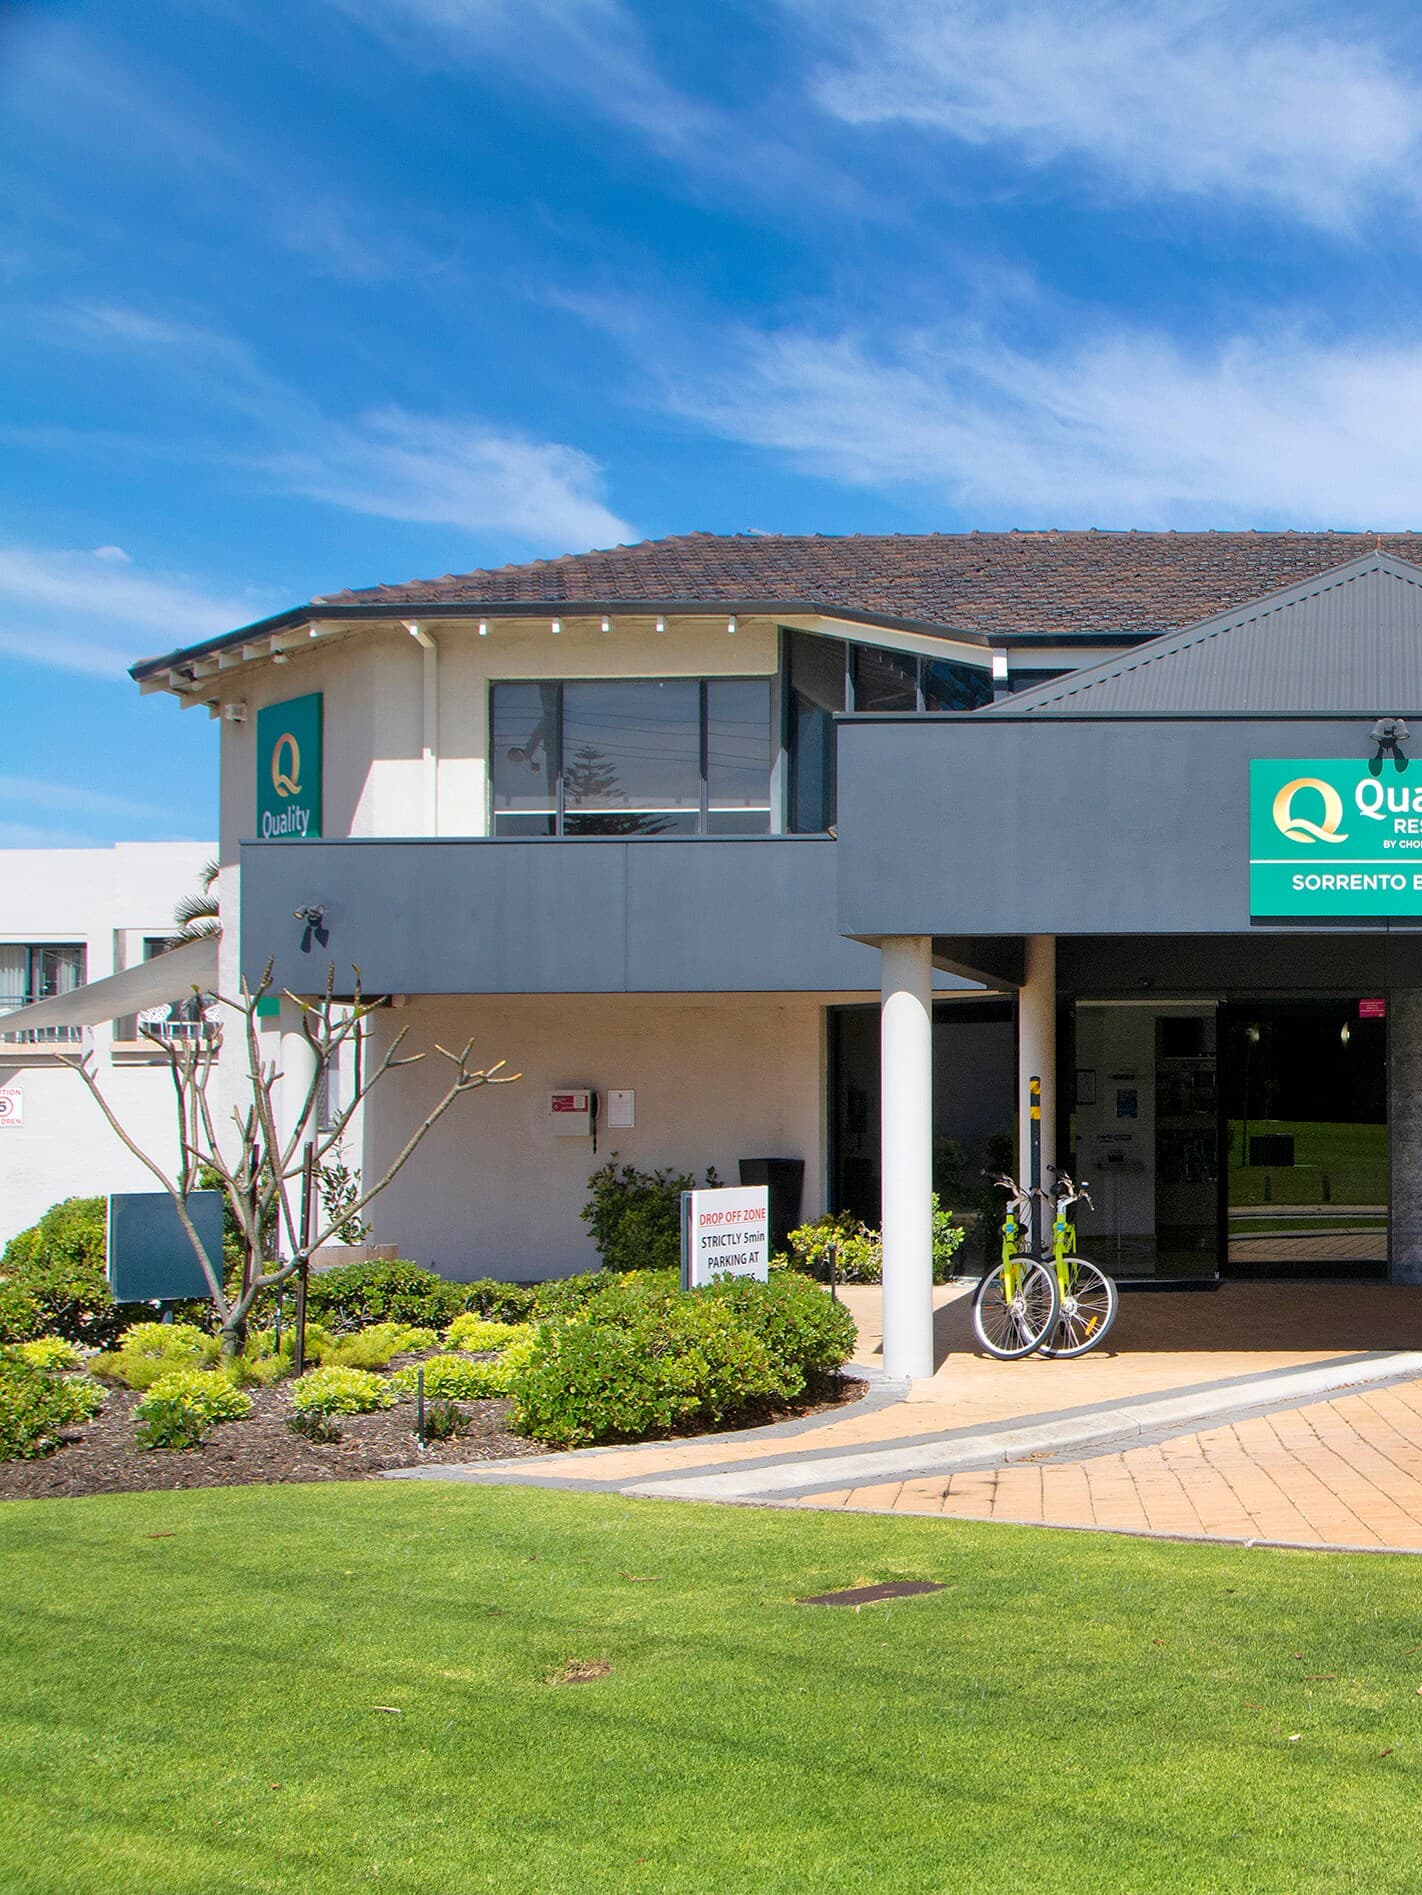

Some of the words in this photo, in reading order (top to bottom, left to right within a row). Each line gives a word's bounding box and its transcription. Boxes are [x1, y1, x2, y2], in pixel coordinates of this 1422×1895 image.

[272, 733, 302, 797] Q
[1272, 777, 1349, 844] Q
[262, 804, 310, 838] Quality
[1383, 839, 1397, 849] BY
[1292, 874, 1407, 891] SORRENTO
[699, 1212, 724, 1226] DROP
[725, 1210, 742, 1223] OFF
[743, 1207, 767, 1221] ZONE
[701, 1232, 742, 1249] STRICTLY
[743, 1230, 766, 1244] 5min
[707, 1253, 747, 1270] PARKING
[748, 1251, 760, 1264] AT
